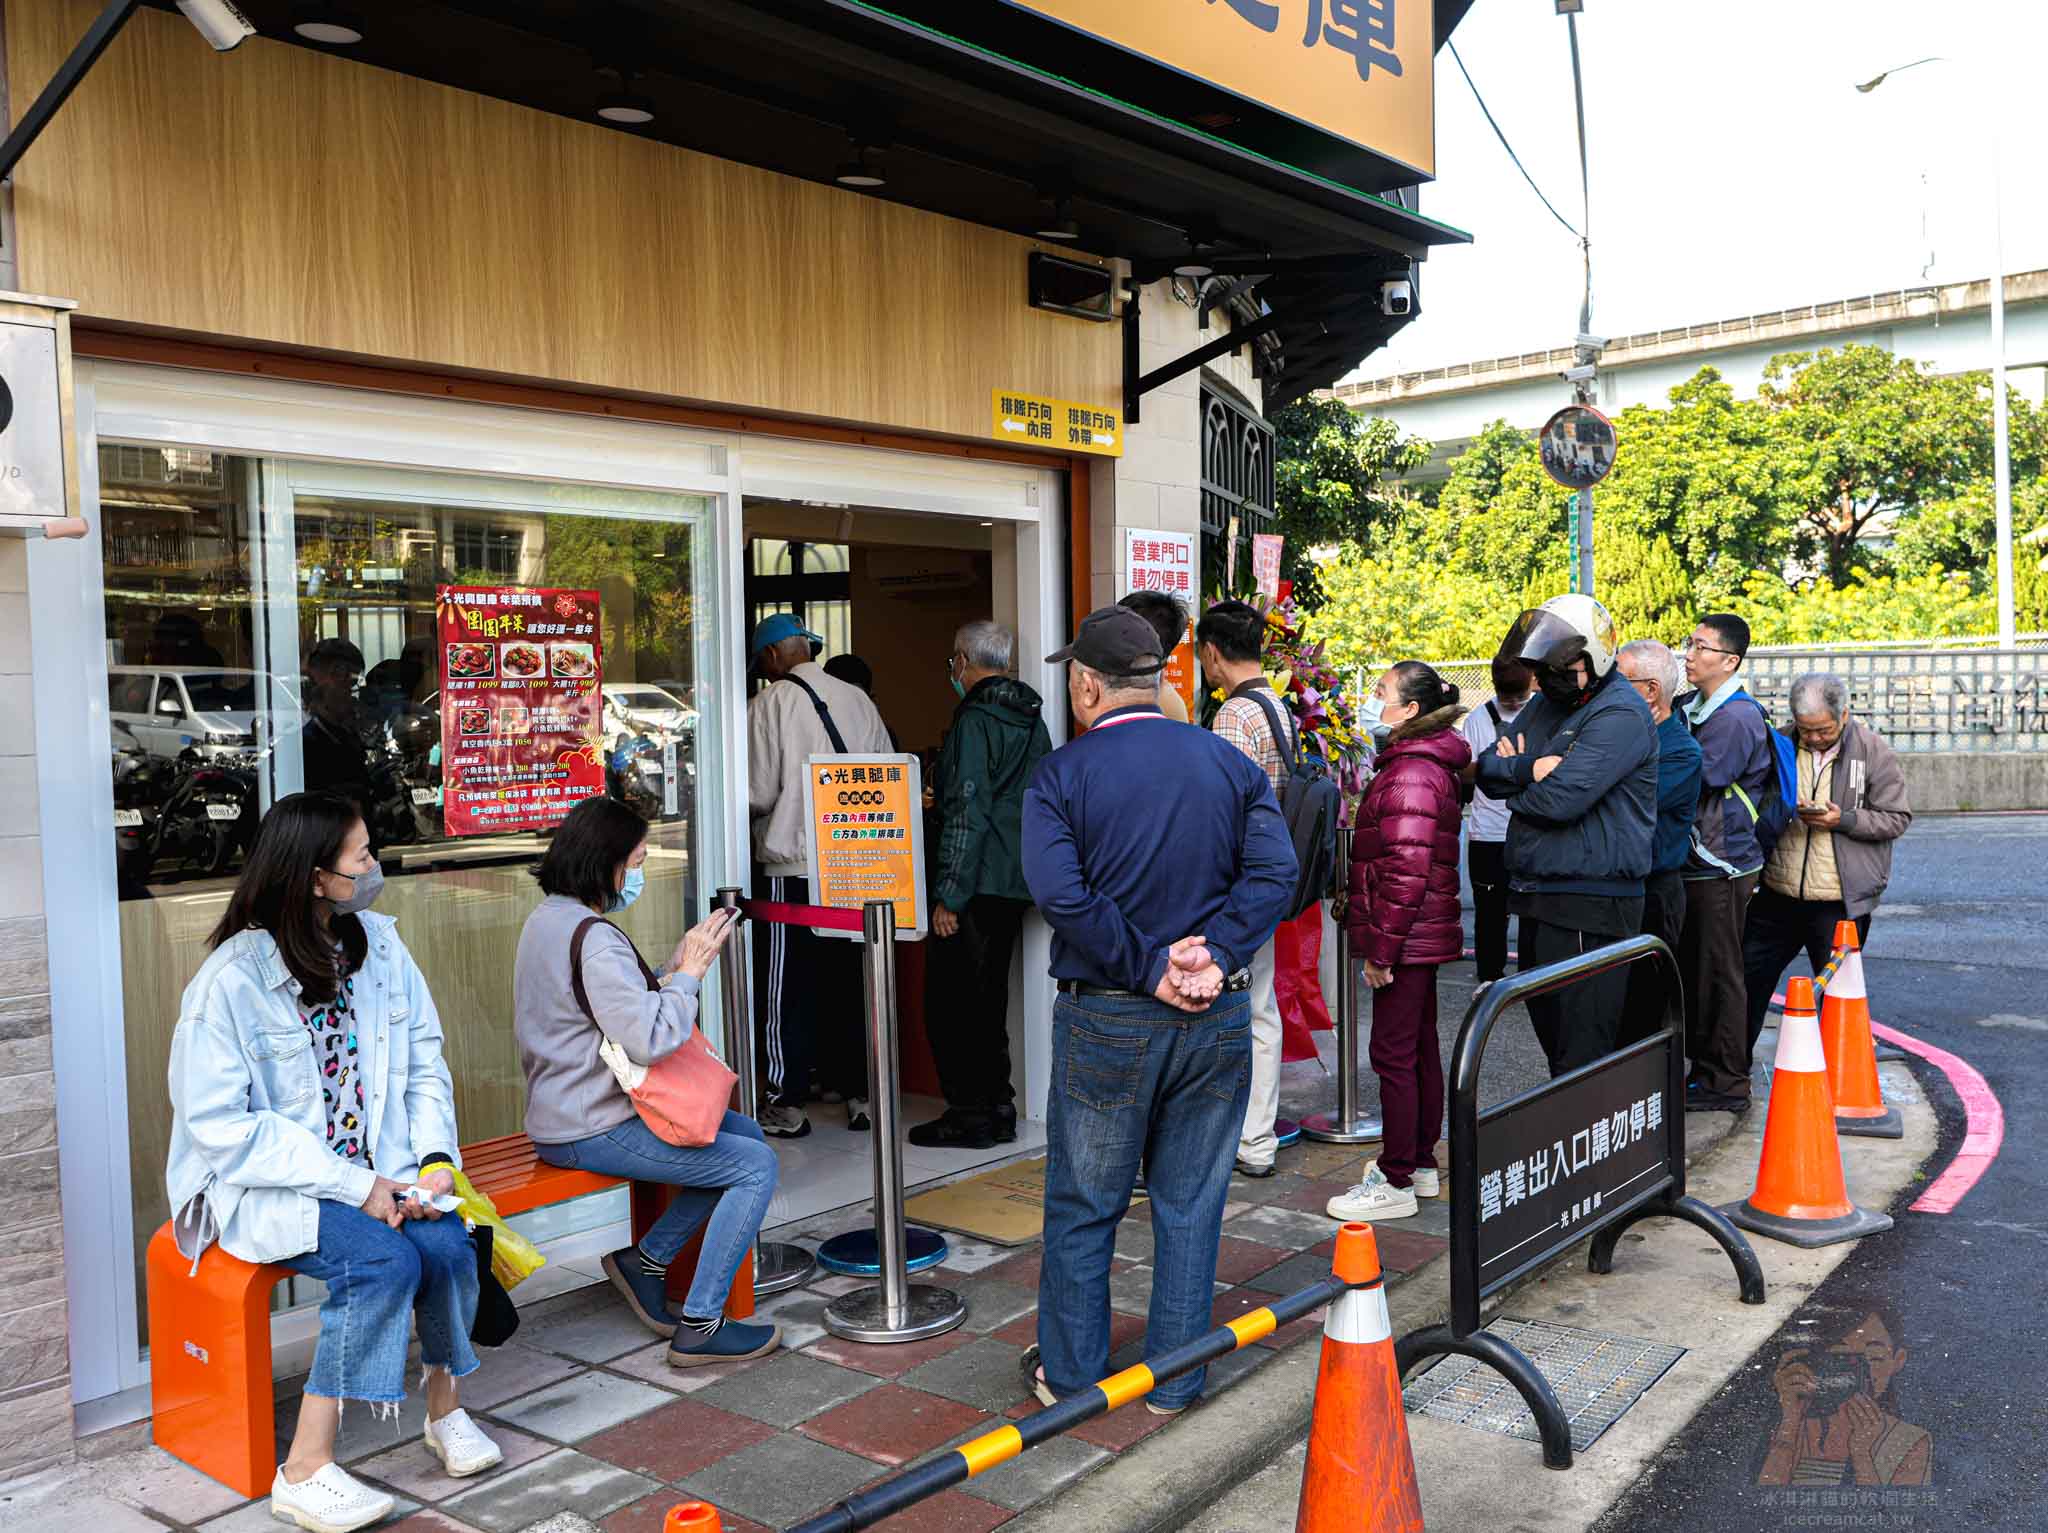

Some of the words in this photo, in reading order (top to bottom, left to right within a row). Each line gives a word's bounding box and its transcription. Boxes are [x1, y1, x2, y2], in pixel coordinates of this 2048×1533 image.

[1000, 397, 1052, 421] 排隊方向
[1068, 407, 1116, 432] 排隊方向
[1026, 420, 1052, 440] 內用
[1068, 428, 1093, 446] 外帶
[1132, 539, 1190, 566] 營業門口
[1132, 568, 1190, 593] 請勿停車
[477, 680, 499, 689] 1099
[528, 680, 549, 689] 1099
[834, 767, 903, 785] 光興腿庫
[1480, 1091, 1664, 1223] 營業出入口請勿停車
